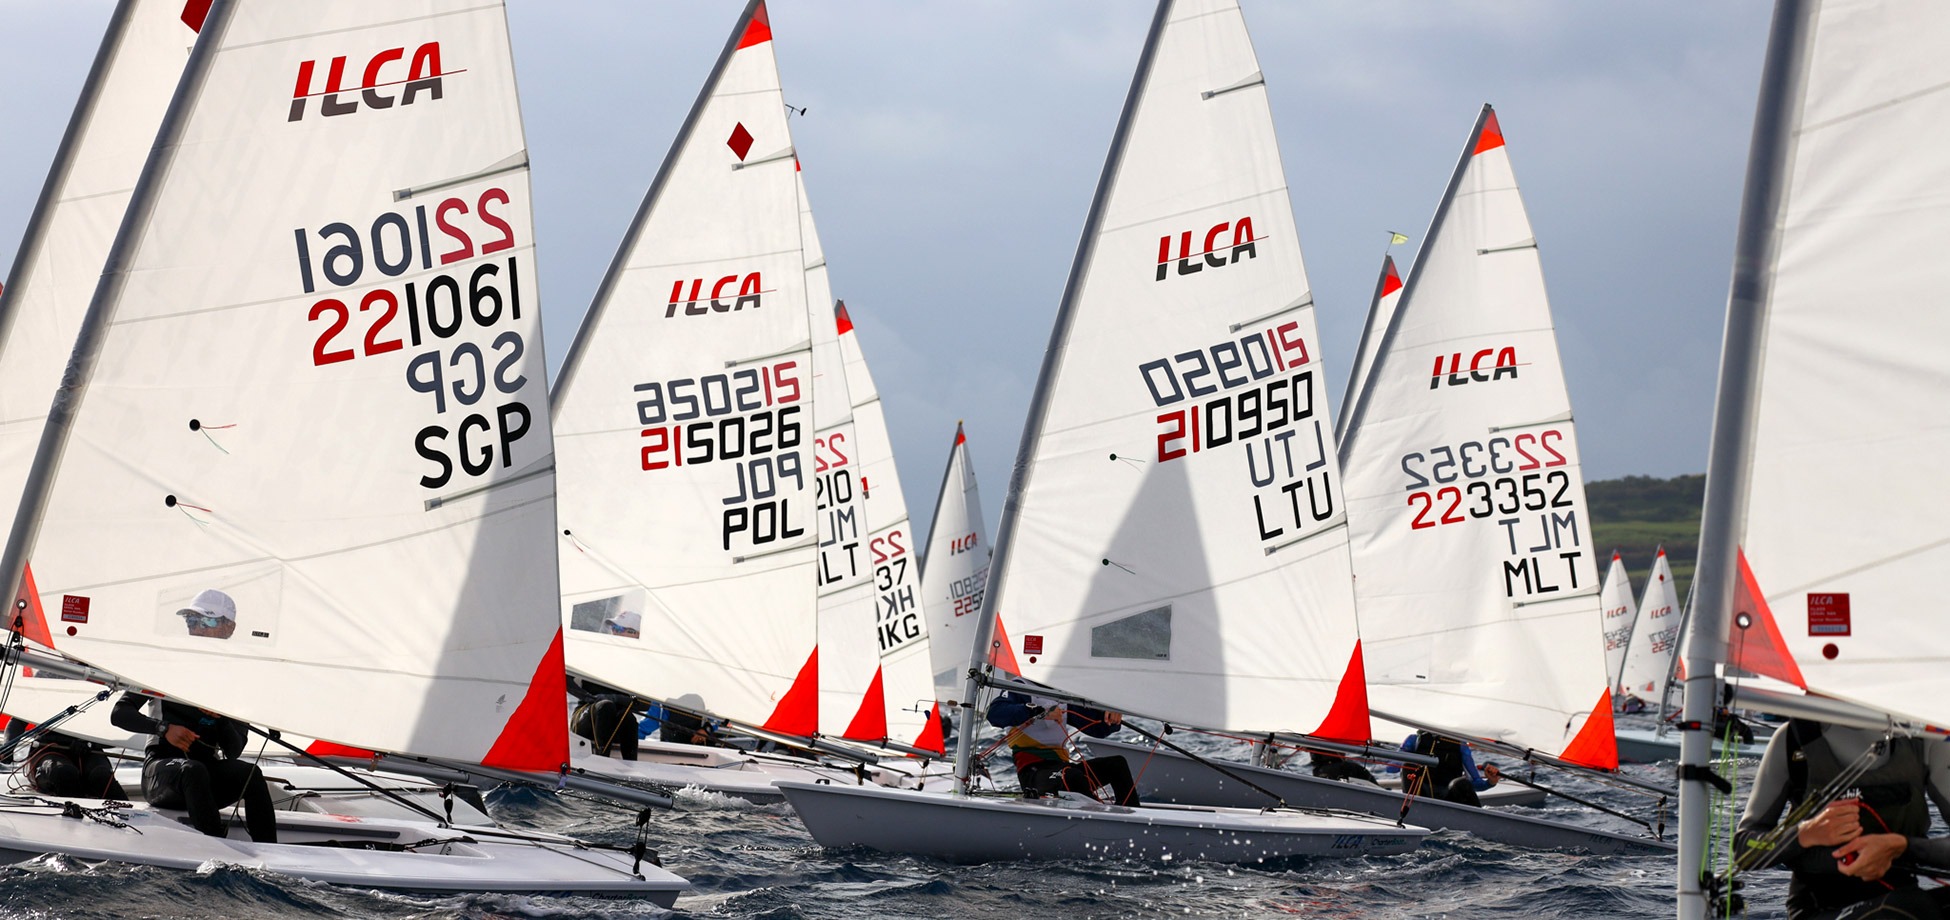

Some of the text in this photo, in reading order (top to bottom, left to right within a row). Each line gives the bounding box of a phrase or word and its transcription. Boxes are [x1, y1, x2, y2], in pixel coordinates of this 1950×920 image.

[288, 41, 443, 122] ILCA
[1155, 216, 1257, 282] ILCA
[308, 257, 522, 366] 221061
[665, 272, 761, 318] ILCA
[1430, 346, 1518, 390] ILCA
[641, 406, 800, 471] 215026
[1157, 370, 1313, 463] 210950
[415, 402, 531, 489] SGP
[1253, 471, 1333, 541] LTU
[1407, 470, 1573, 530] 223352
[723, 499, 804, 550] POL
[951, 532, 978, 556] ILCA
[818, 542, 859, 586] LT
[1503, 551, 1581, 597] MLT
[1606, 605, 1627, 619] ILCA
[1650, 605, 1672, 619] ILCA
[1810, 596, 1833, 605] ILCA
[1331, 835, 1363, 849] ILCA
